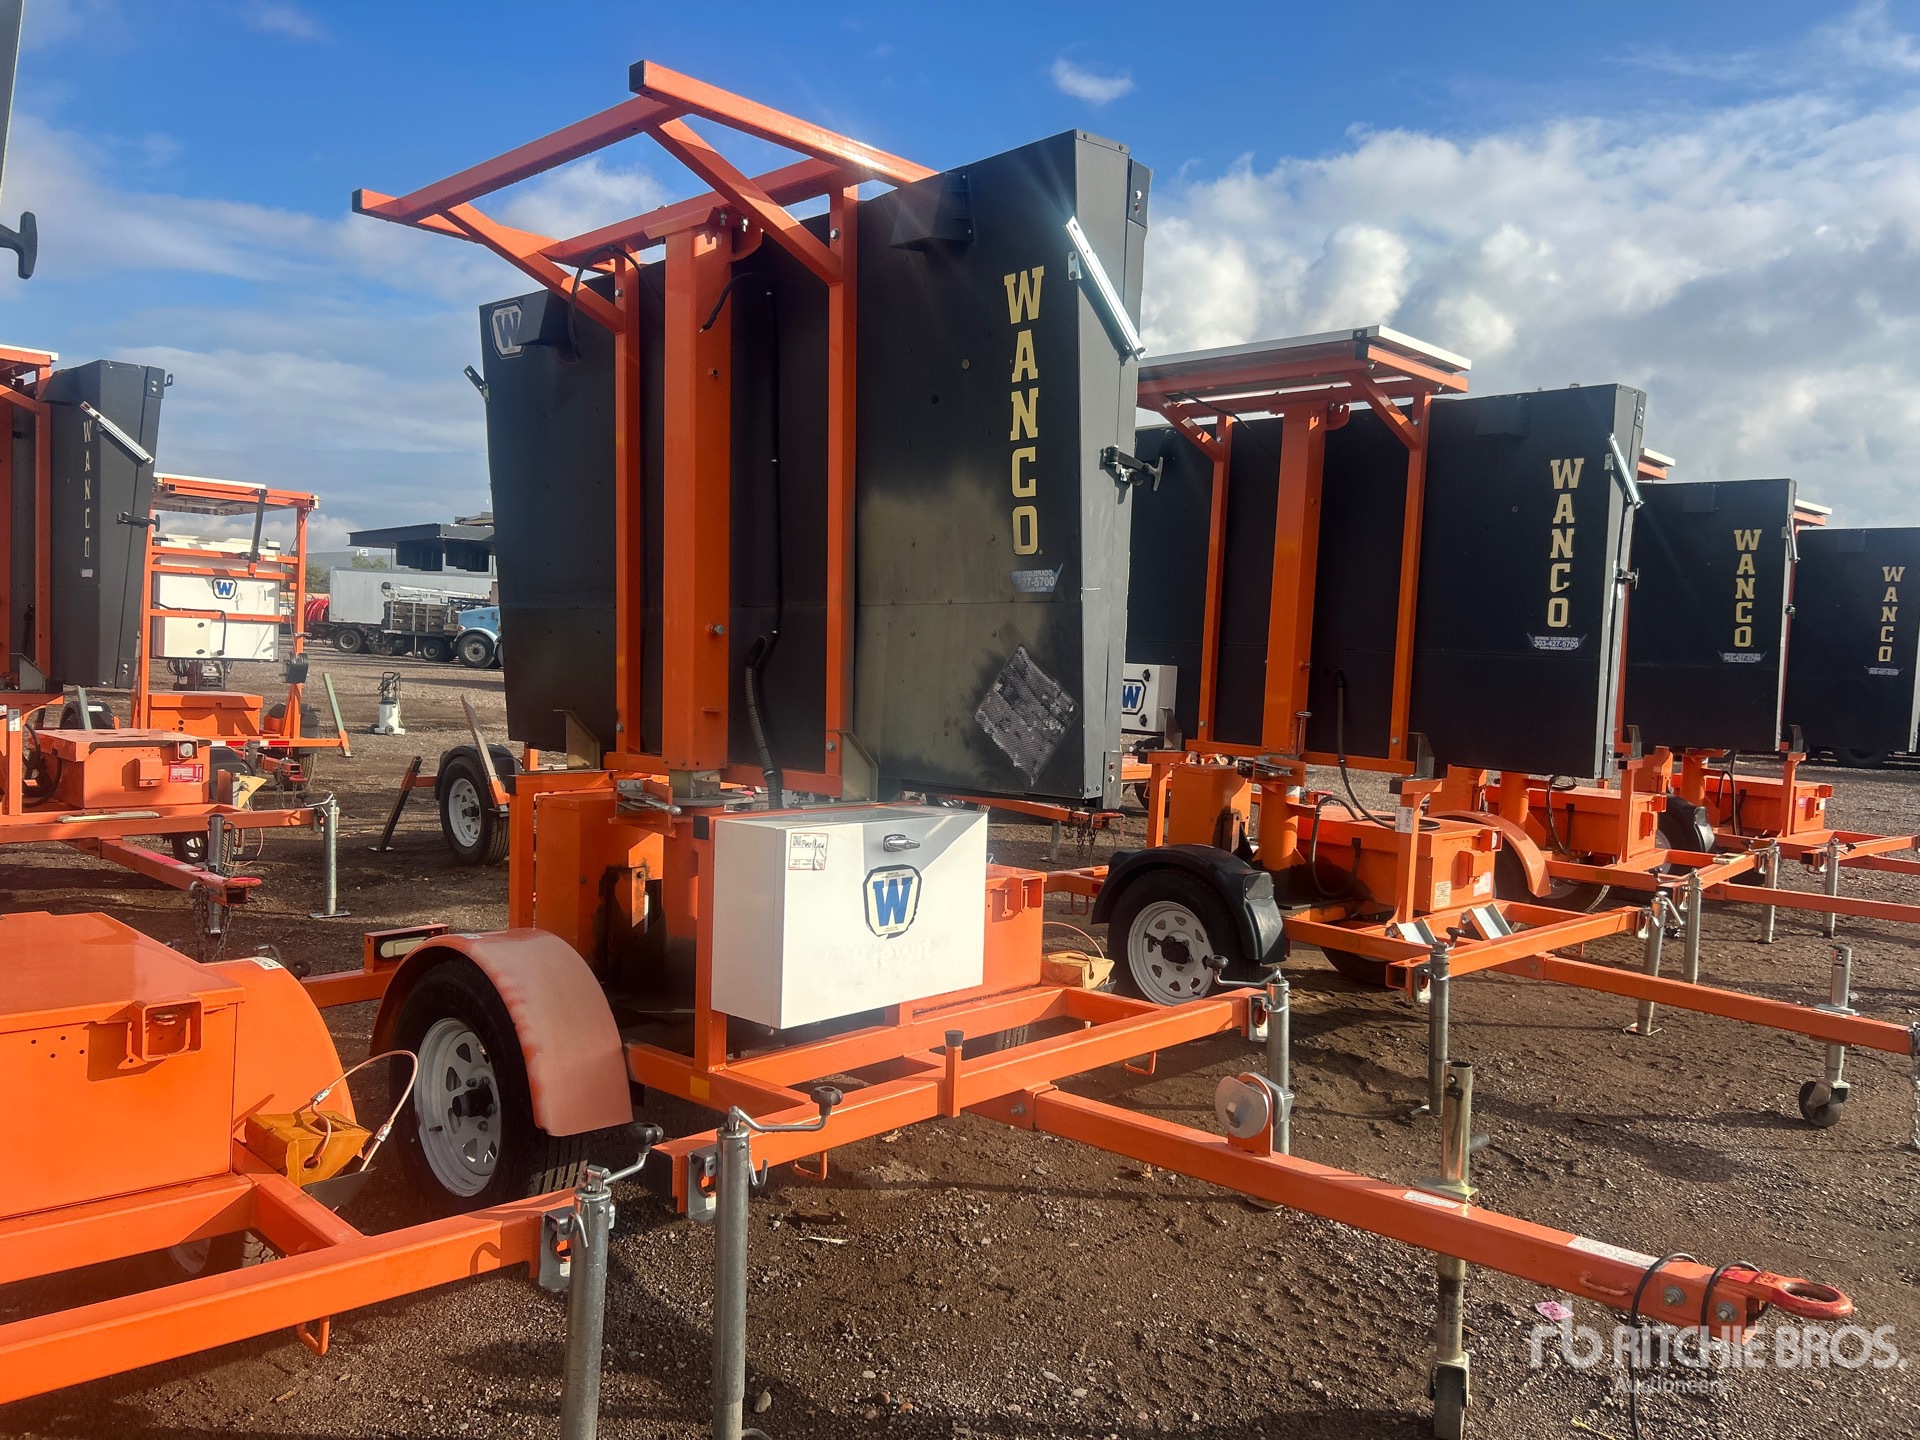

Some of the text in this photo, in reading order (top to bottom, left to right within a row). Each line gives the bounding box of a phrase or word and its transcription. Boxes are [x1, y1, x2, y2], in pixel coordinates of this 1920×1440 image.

[1003, 265, 1045, 555] WANCO
[83, 420, 92, 558] WANCO
[216, 581, 233, 596] W
[1547, 457, 1585, 628] WANCO
[1733, 528, 1763, 648] WANCO
[1534, 640, 1579, 648] 303-427-5700
[1878, 566, 1906, 662] WANCO
[1122, 685, 1142, 709] W
[872, 876, 913, 927] W
